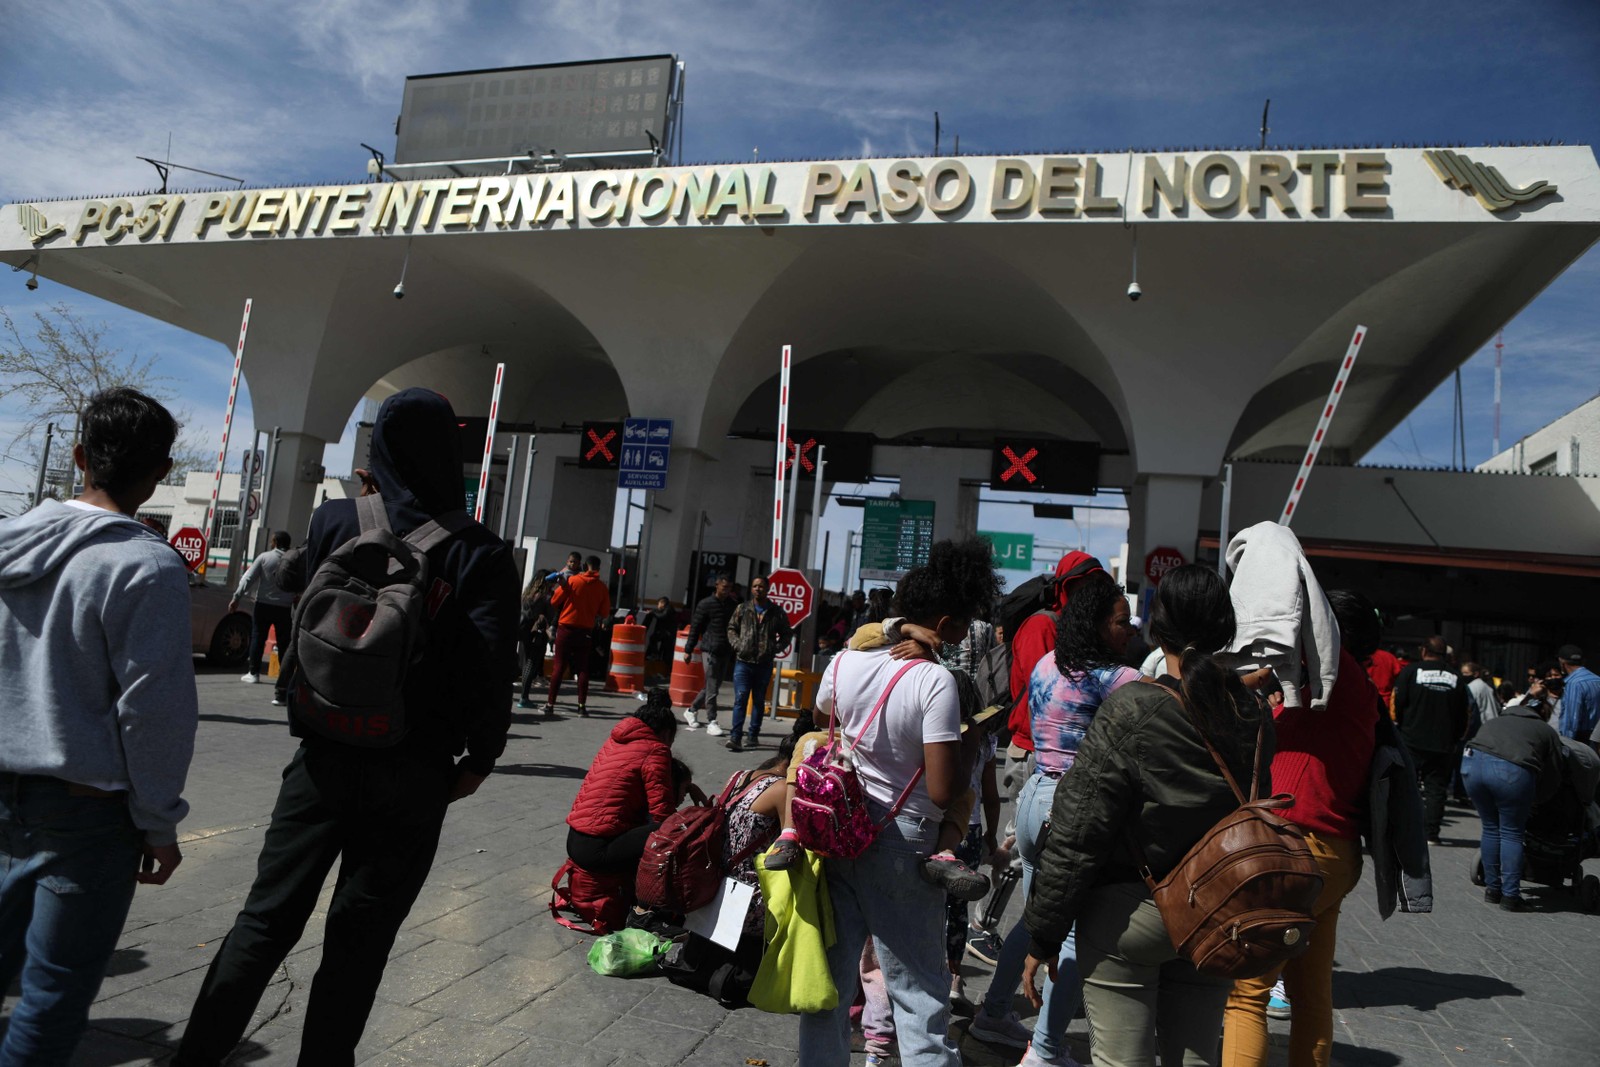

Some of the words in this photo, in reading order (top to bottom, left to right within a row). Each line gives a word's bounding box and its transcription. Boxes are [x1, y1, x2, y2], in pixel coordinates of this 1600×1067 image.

[72, 196, 184, 244] PC-51
[194, 187, 370, 236] PUENTE
[369, 168, 788, 230] INTERNACIONAL
[803, 159, 972, 216] PASO
[991, 157, 1118, 212] DEL
[1142, 153, 1389, 212] NORTE
[175, 537, 202, 549] ALTO
[702, 553, 727, 567] 103
[1151, 555, 1182, 567] ALTO
[767, 583, 806, 598] ALTO
[770, 599, 804, 615] TOP
